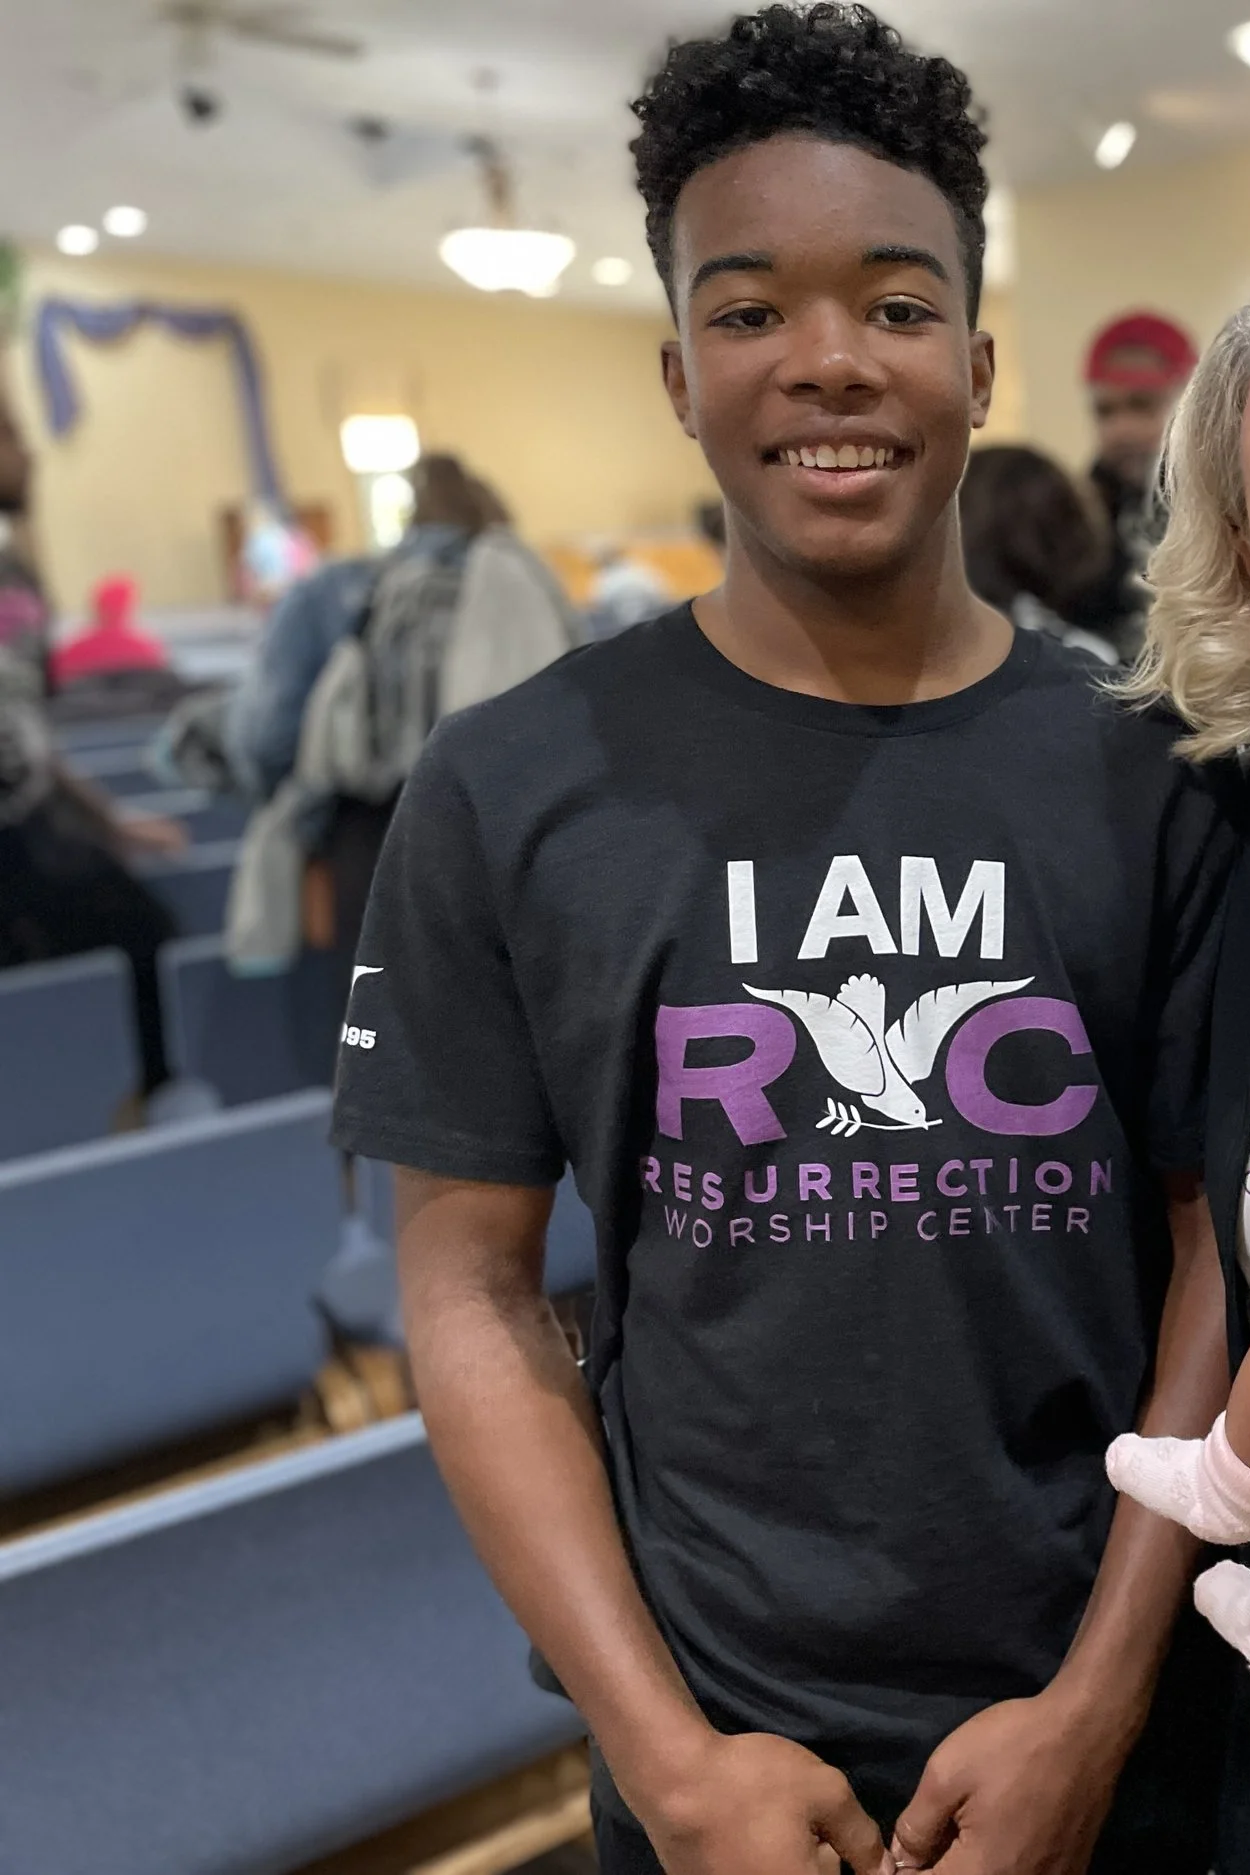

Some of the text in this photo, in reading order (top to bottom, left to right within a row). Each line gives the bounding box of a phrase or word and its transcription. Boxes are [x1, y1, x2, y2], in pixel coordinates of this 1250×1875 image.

[727, 855, 1005, 963] I AM
[640, 1156, 1113, 1210] RESURRECTION
[664, 1204, 1090, 1248] WORSHIP CENTER
